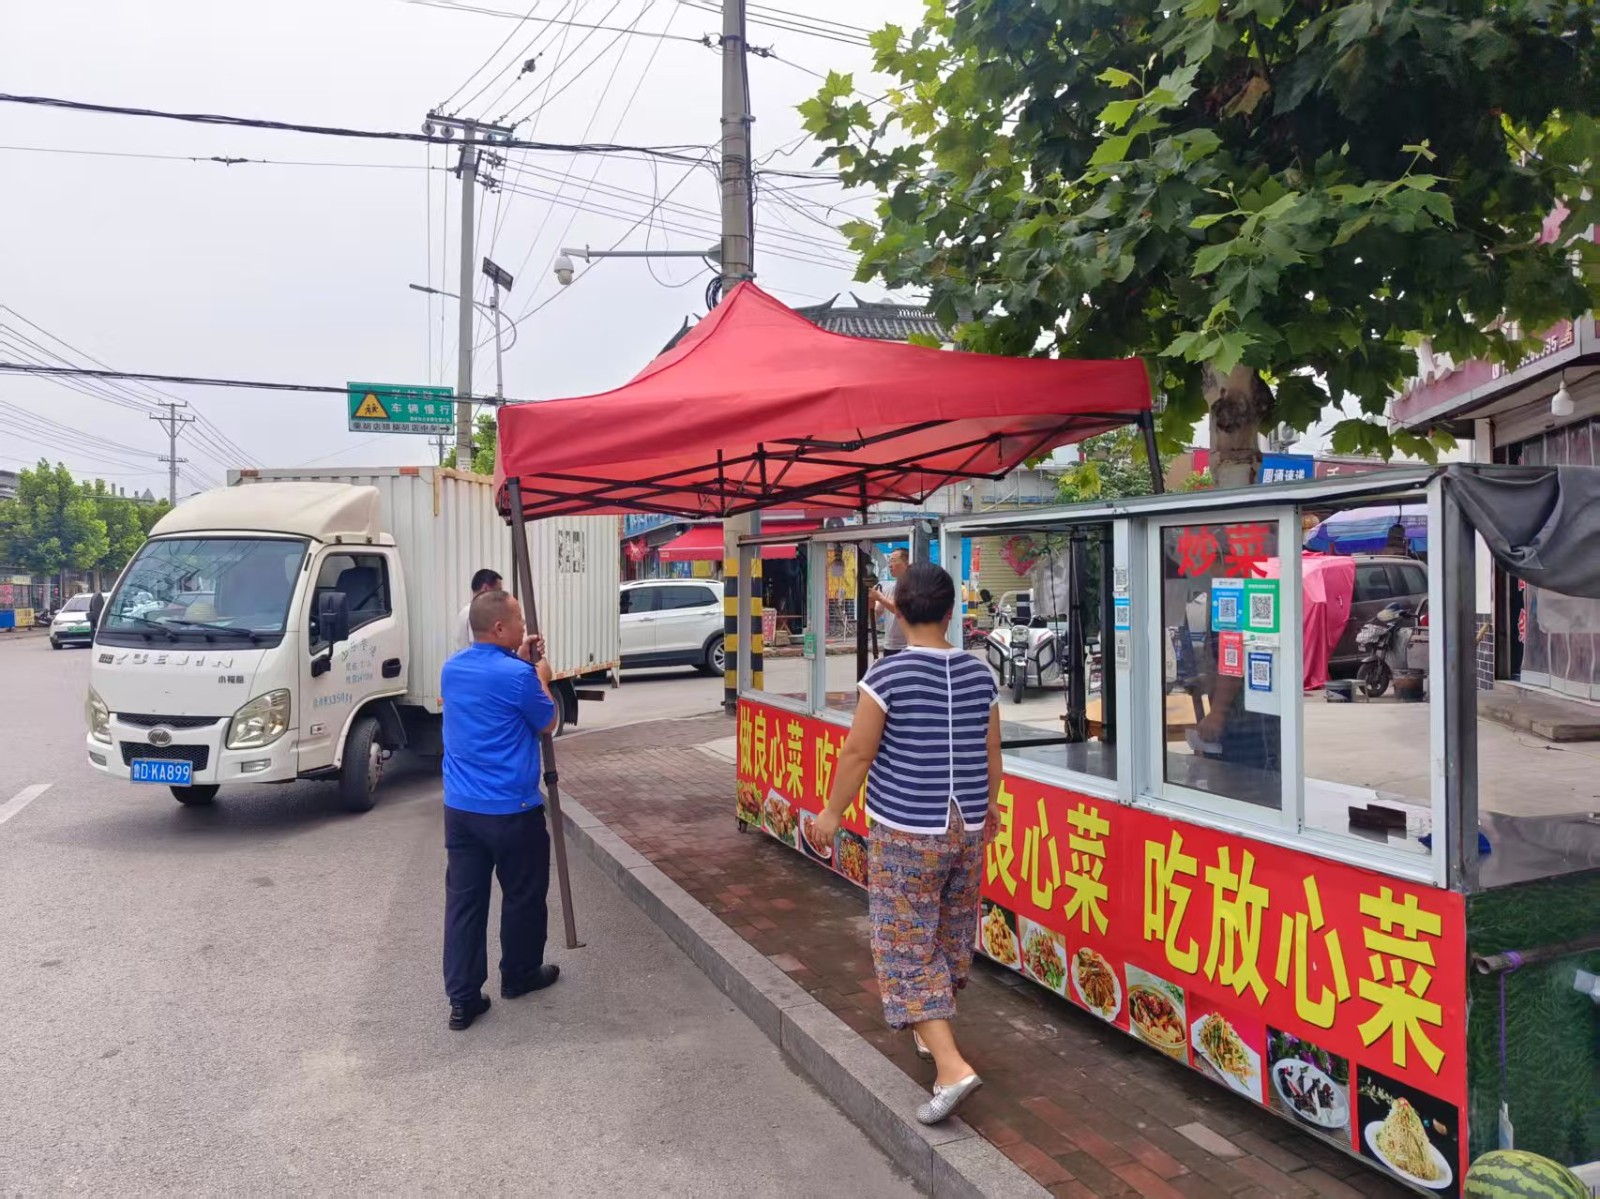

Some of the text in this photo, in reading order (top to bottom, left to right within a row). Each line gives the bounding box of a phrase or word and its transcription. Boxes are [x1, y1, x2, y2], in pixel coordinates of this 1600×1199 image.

[391, 403, 450, 415] 车辆慢行
[1177, 522, 1270, 579] 炒菜
[116, 653, 233, 668] YUEJIN
[739, 704, 804, 799] 做良心菜
[1143, 829, 1446, 1076] 吃放心菜
